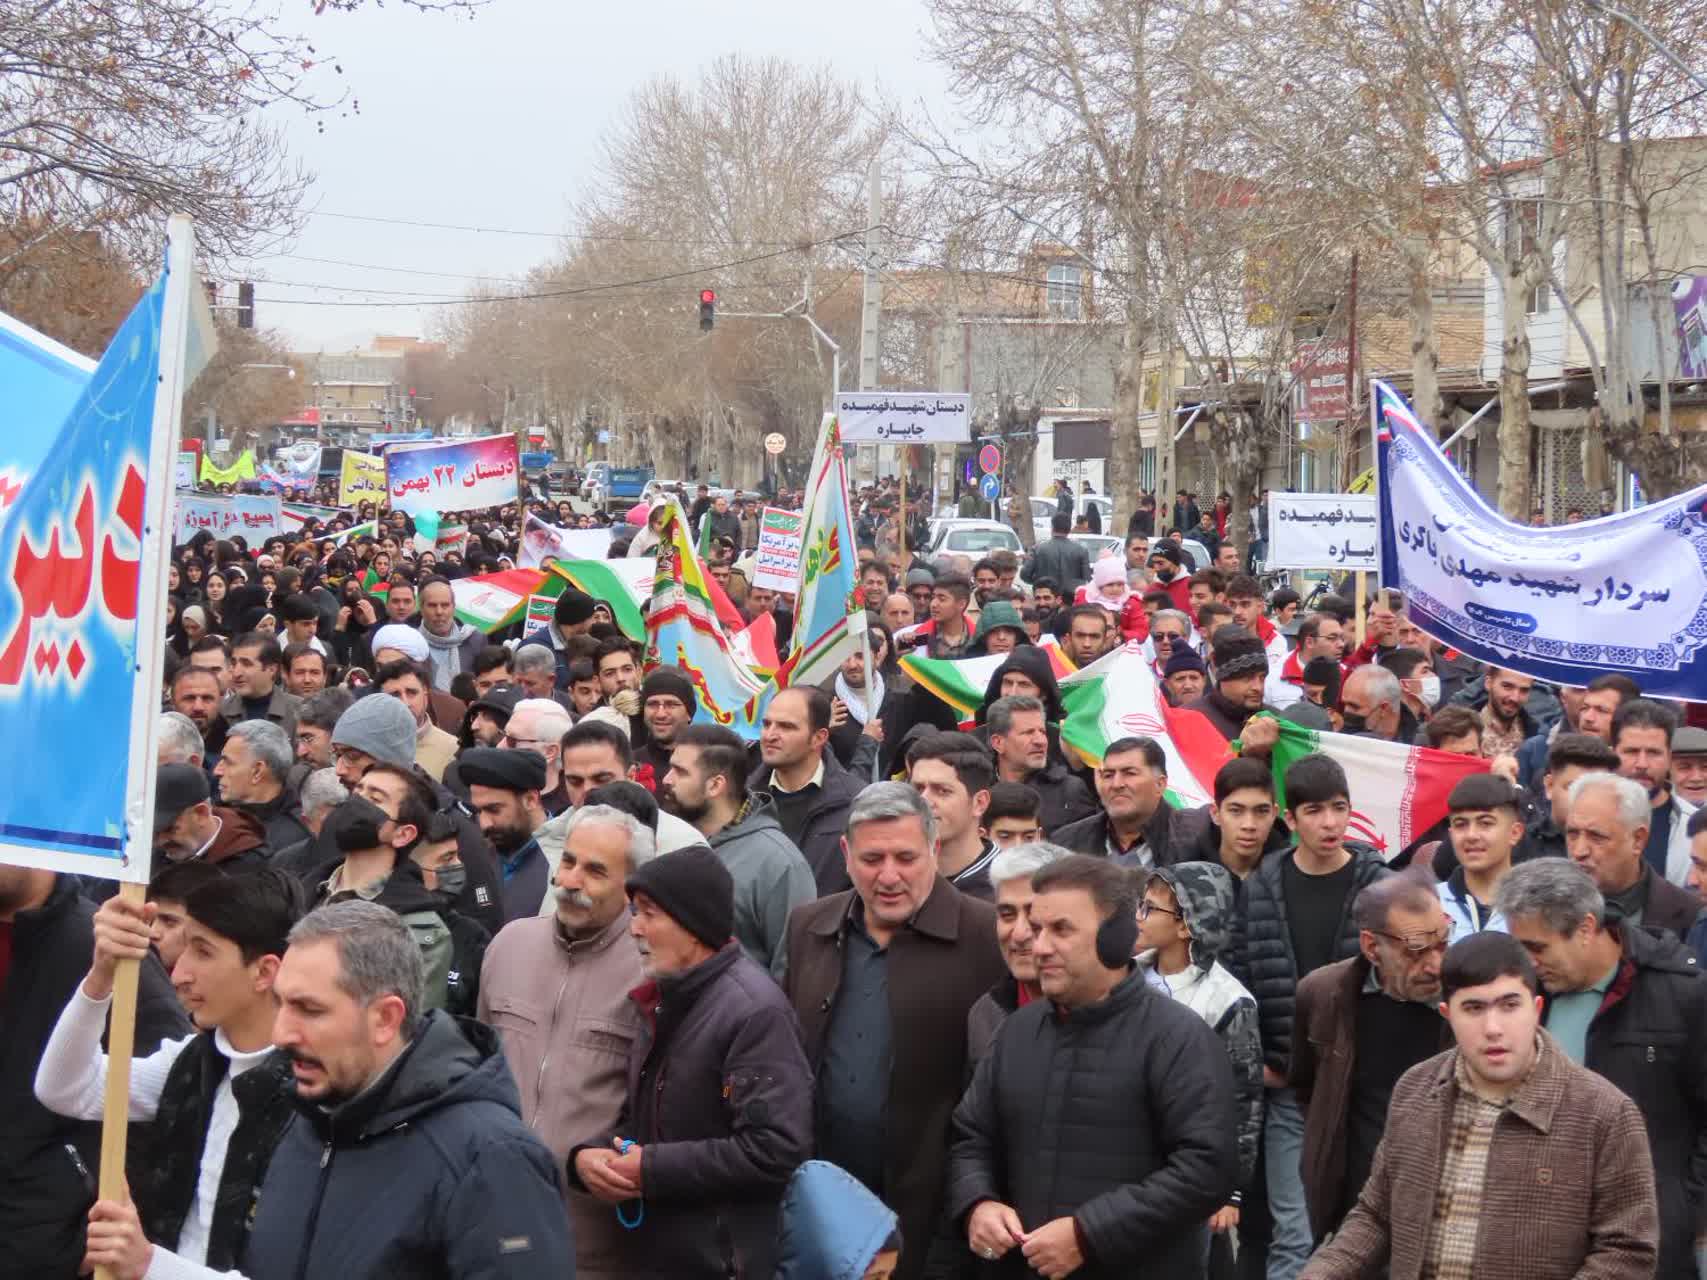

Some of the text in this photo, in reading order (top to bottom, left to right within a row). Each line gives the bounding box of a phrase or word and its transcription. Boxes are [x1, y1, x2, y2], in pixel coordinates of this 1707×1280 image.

[841, 398, 965, 415] دبستان شهید فهمیده
[393, 458, 514, 497] دبستان ۲۲ بهمن
[242, 511, 274, 529] بسیج
[1279, 503, 1343, 527] فهمیده
[1328, 539, 1375, 563] یپاره
[1399, 520, 1437, 566] باکری
[1440, 556, 1502, 588] مهدی
[1508, 572, 1581, 598] شهید
[1582, 575, 1671, 611] سردار
